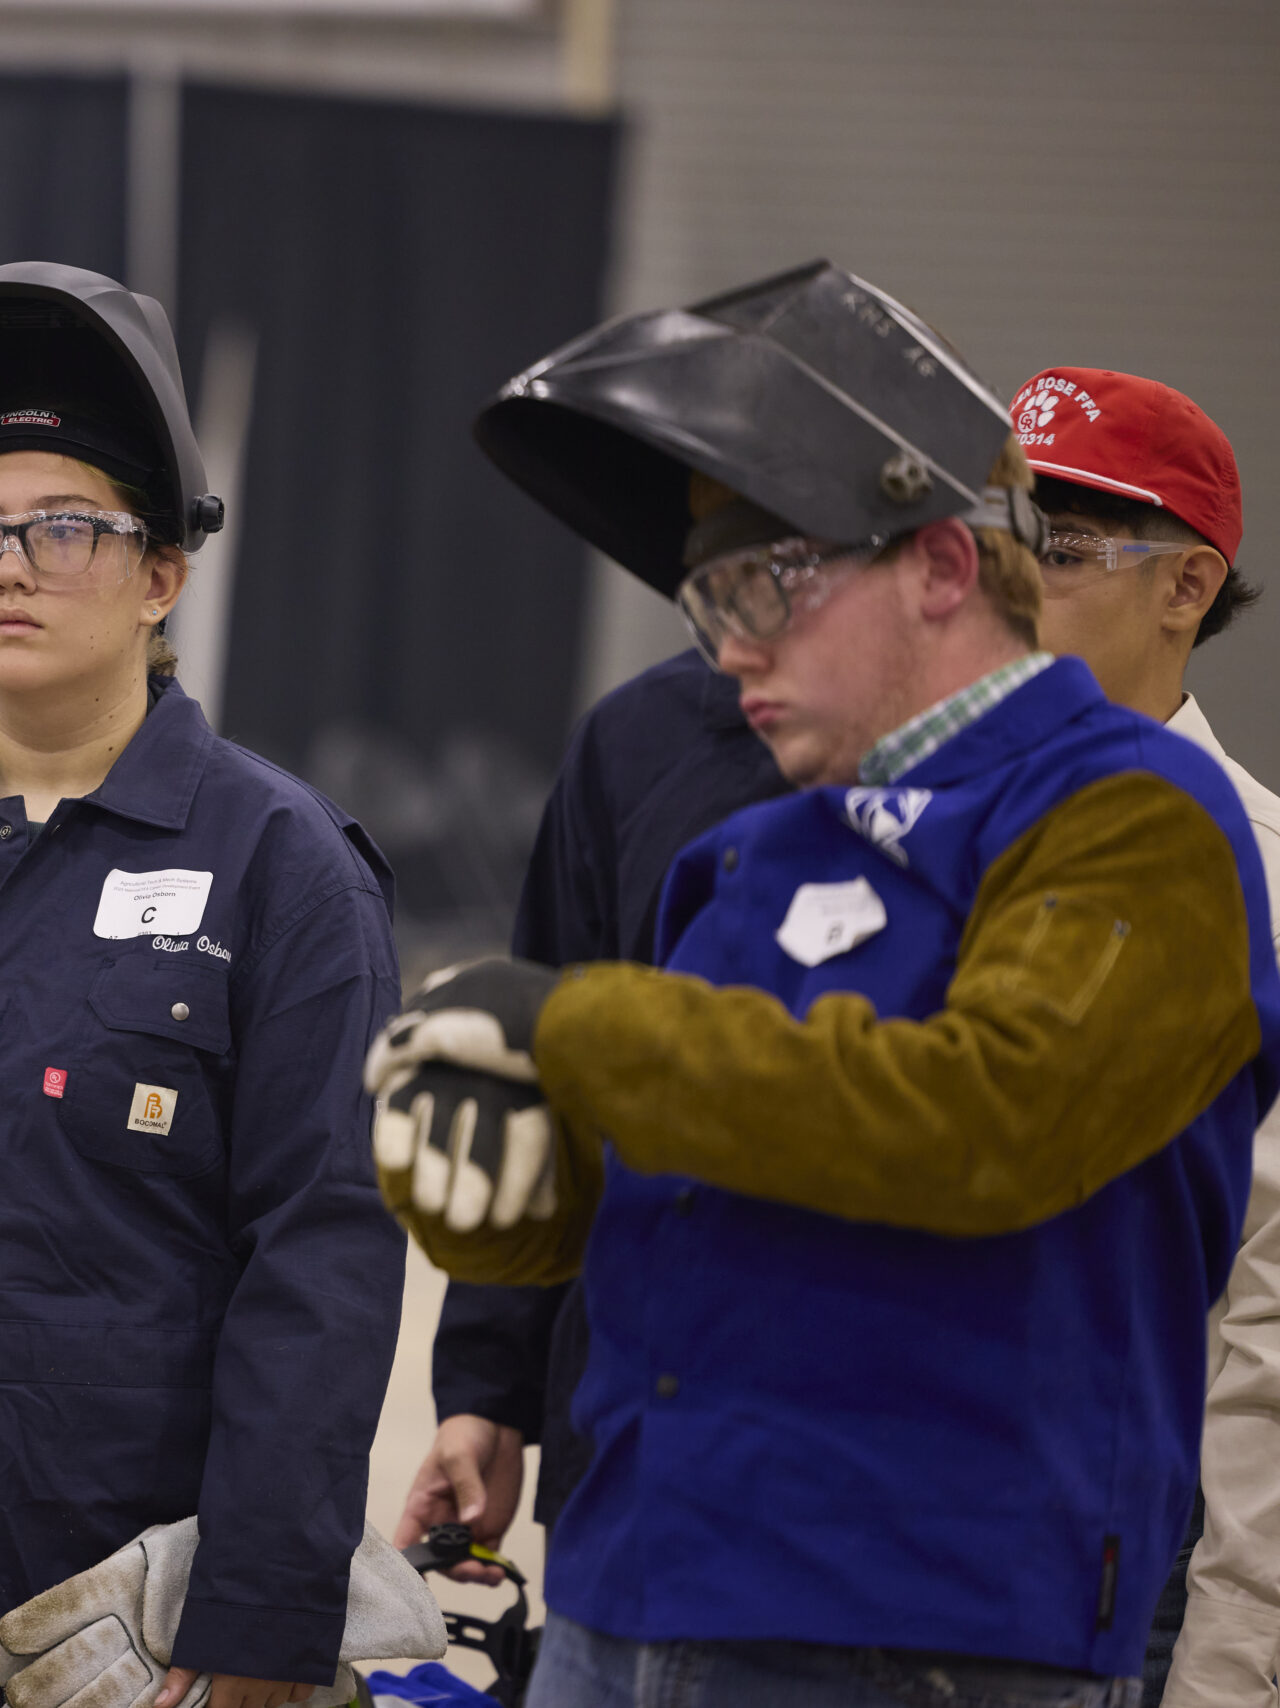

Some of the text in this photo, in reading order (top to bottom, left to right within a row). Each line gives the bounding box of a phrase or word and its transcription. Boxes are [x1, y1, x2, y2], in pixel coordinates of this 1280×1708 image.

[1035, 376, 1077, 397] ROSE
[1074, 390, 1102, 423] FFA
[0, 410, 50, 419] LINCOLN
[8, 416, 54, 425] ELECTRIC
[141, 906, 157, 924] C
[152, 935, 190, 953] Olivia
